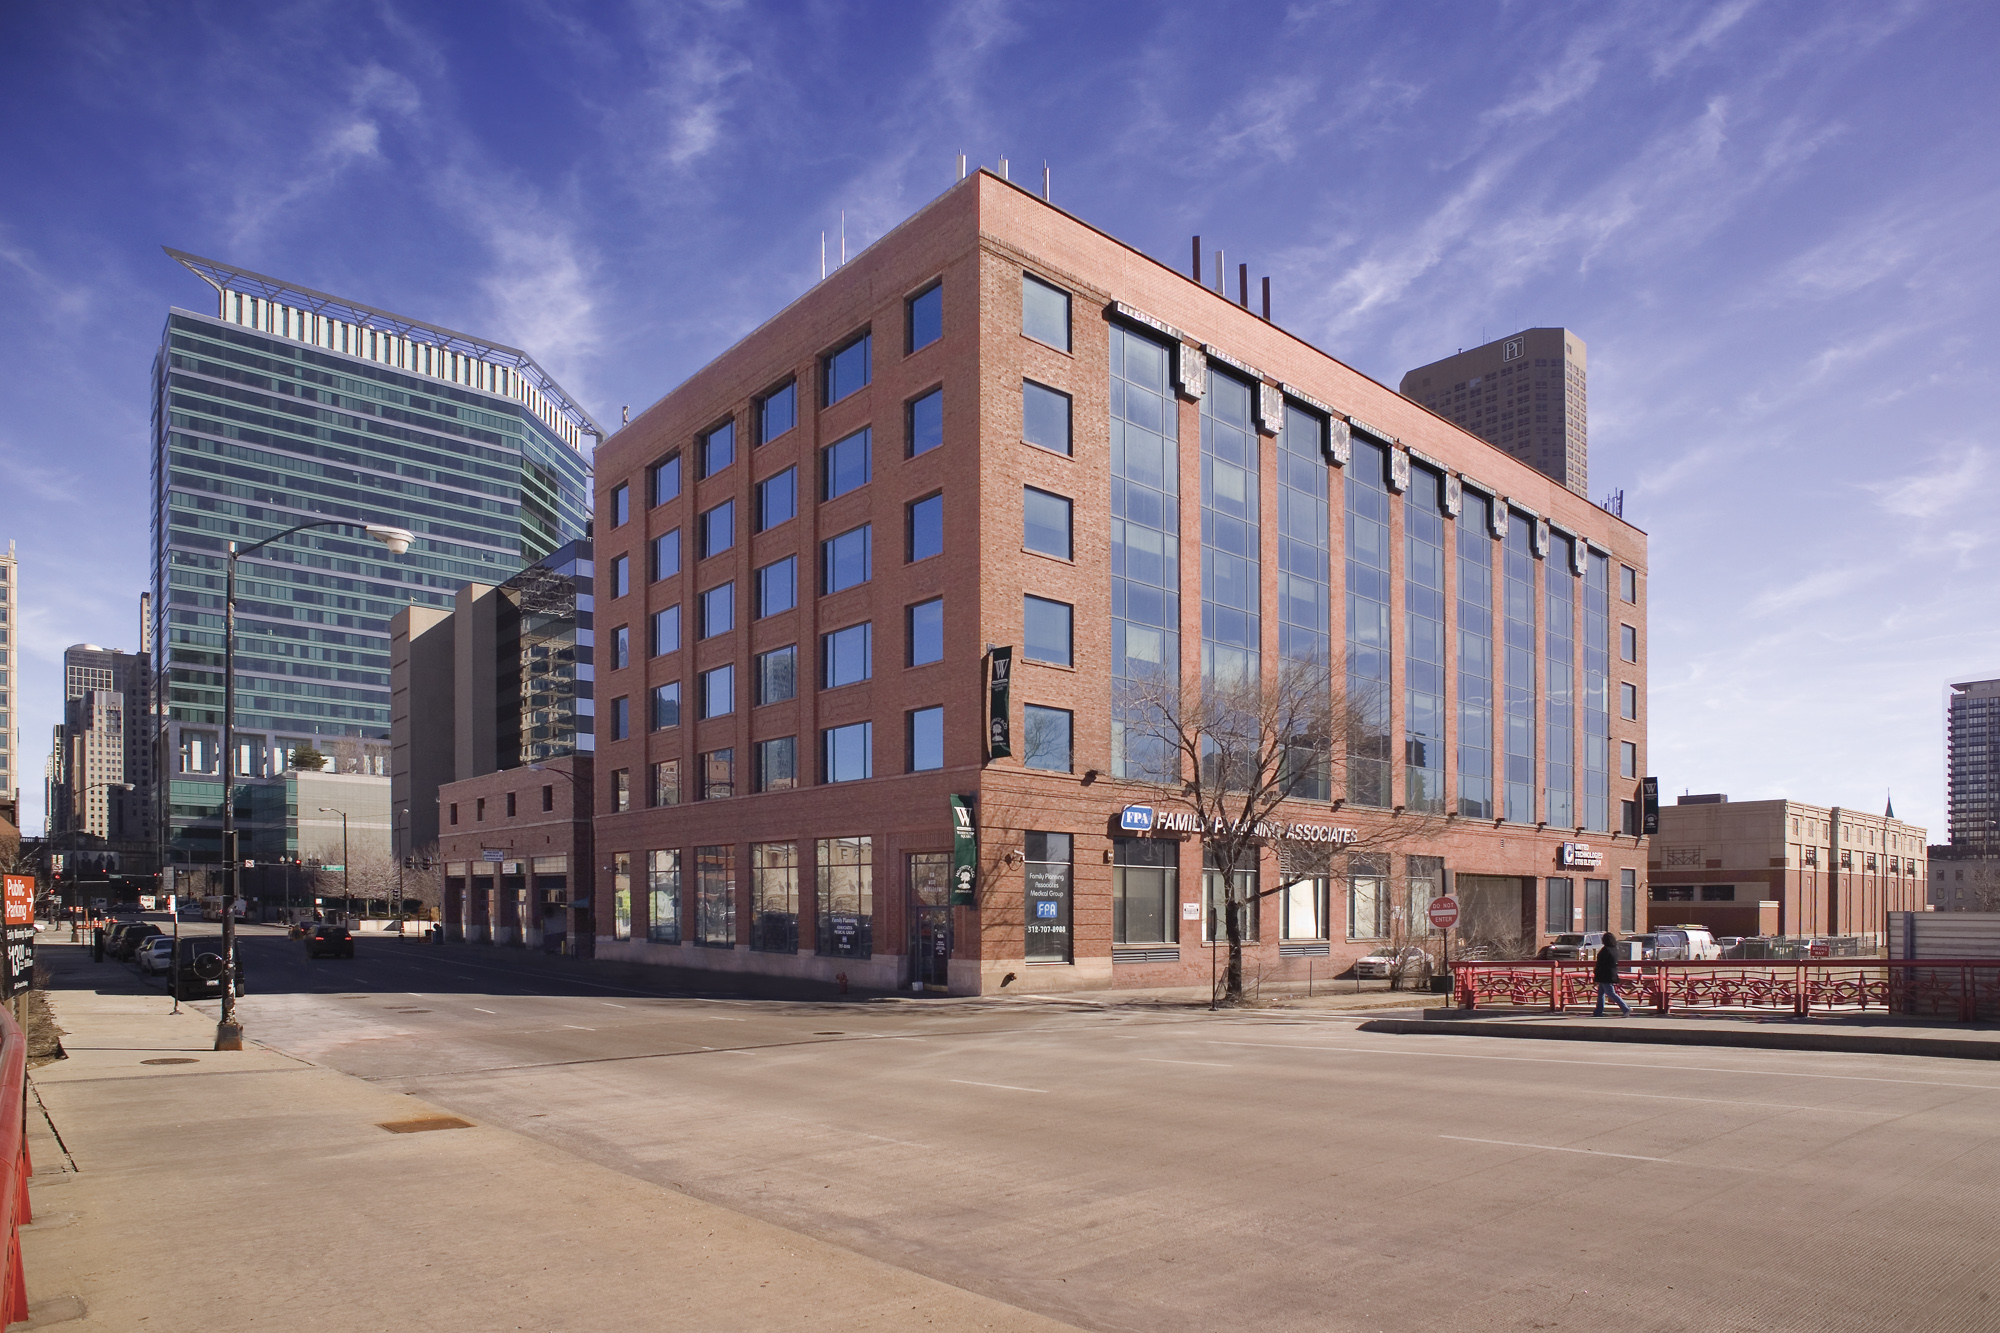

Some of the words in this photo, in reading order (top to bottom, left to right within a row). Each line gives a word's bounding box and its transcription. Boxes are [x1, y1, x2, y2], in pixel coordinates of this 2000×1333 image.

[994, 659, 1010, 679] W
[1644, 783, 1656, 793] W
[954, 807, 972, 827] W
[1126, 811, 1149, 825] FPA
[1286, 823, 1358, 844] ASSOCIATES
[1030, 873, 1044, 881] Family
[1045, 873, 1065, 882] Planning
[7, 879, 25, 897] Public
[1049, 890, 1064, 898] Group
[6, 900, 27, 921] Parking
[1038, 904, 1056, 916] FPA
